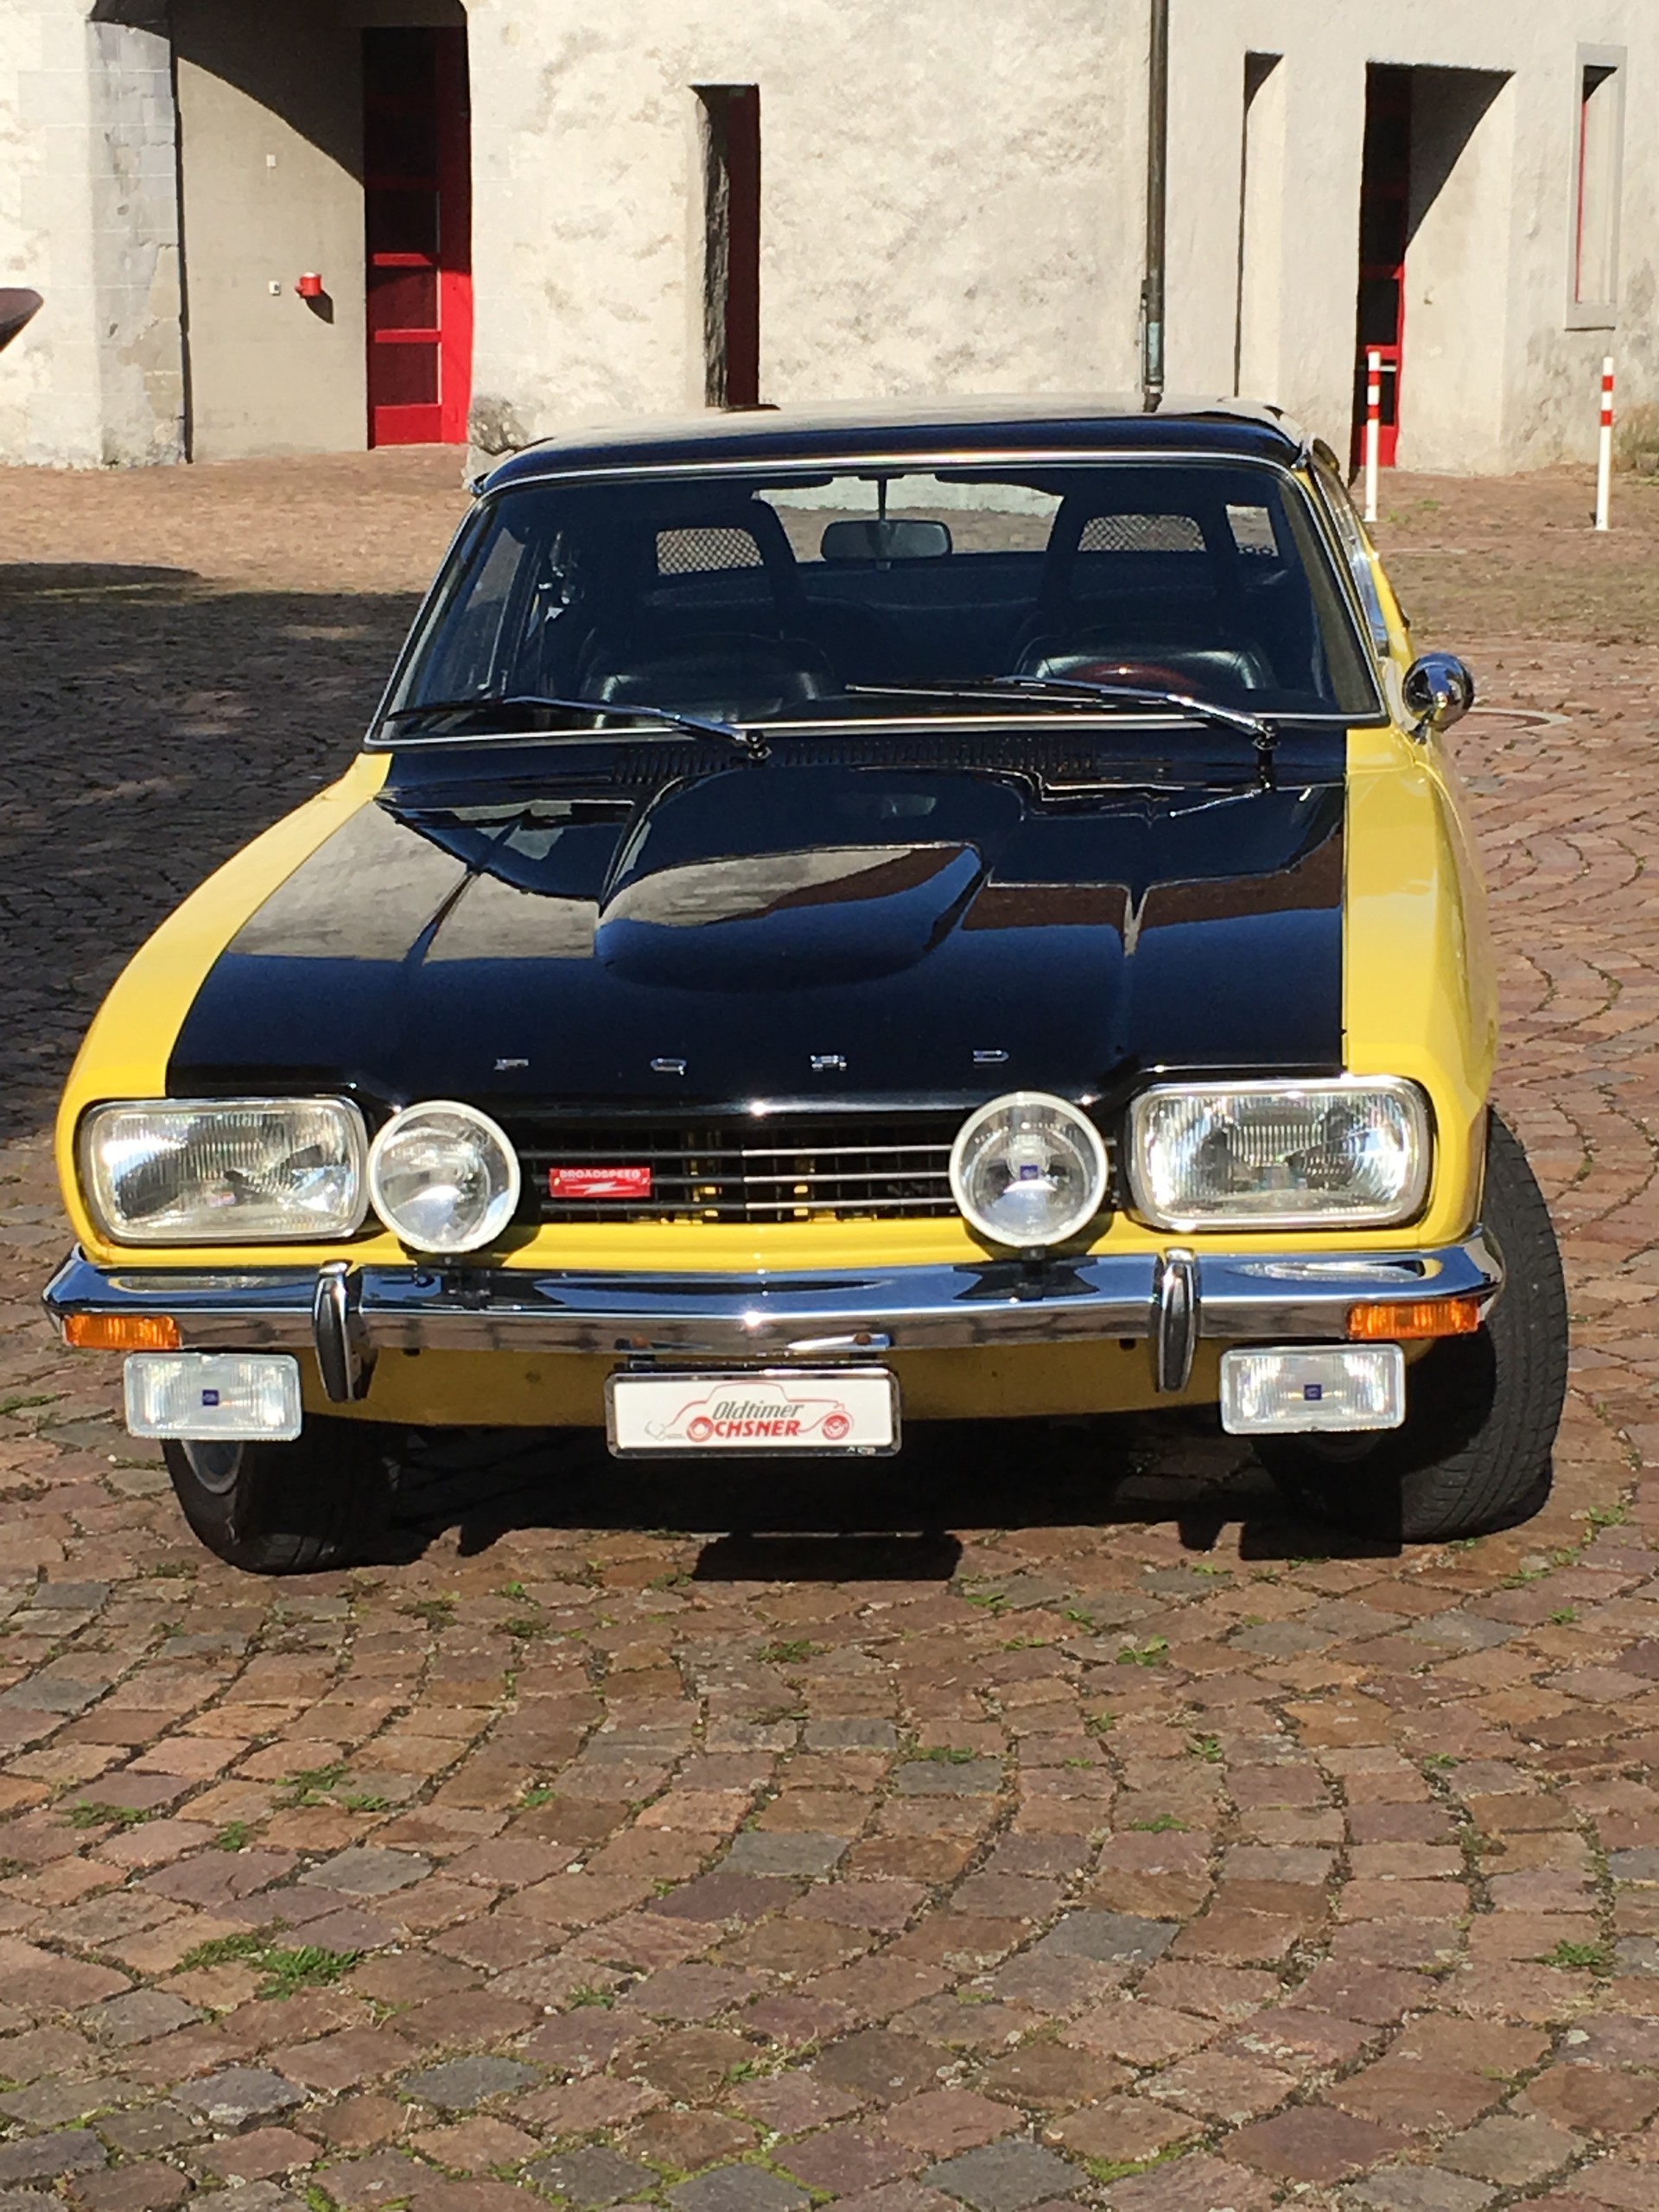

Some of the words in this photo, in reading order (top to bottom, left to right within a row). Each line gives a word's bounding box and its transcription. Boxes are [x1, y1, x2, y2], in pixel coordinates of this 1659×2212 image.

[493, 1049, 1010, 1075] FORD
[712, 1400, 804, 1420] Oldtimer
[686, 1416, 802, 1442] OCHSNER
